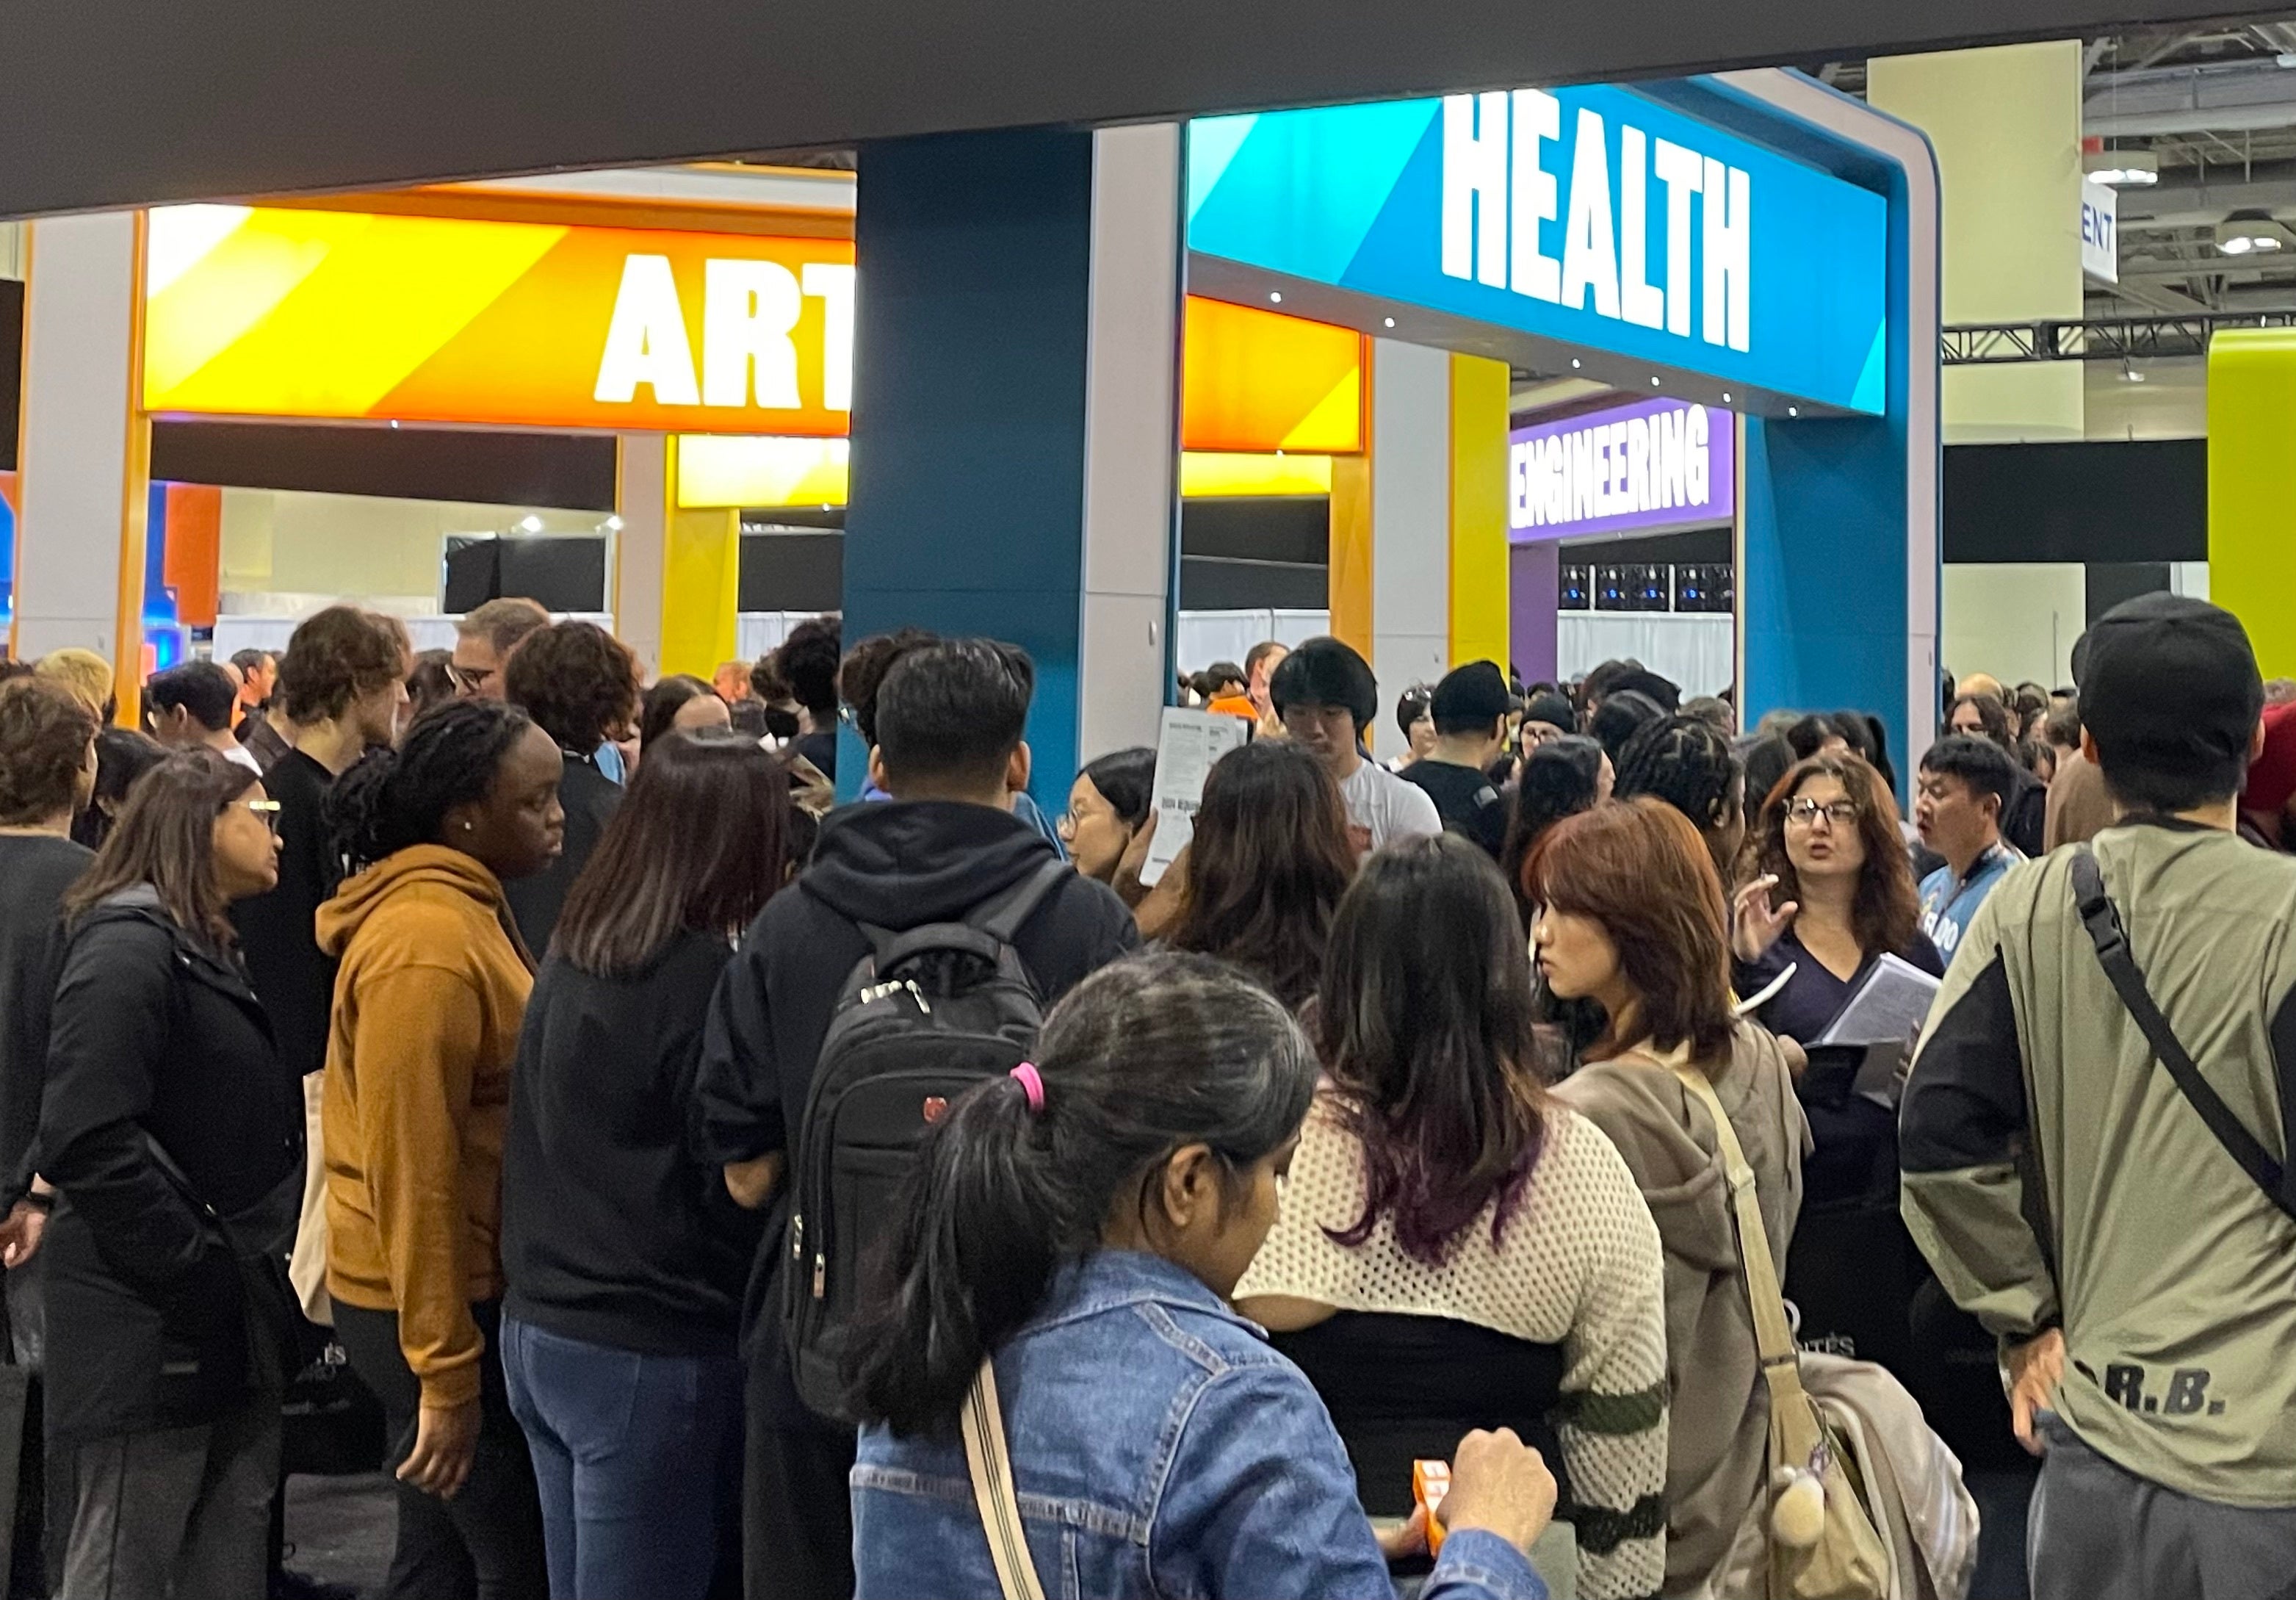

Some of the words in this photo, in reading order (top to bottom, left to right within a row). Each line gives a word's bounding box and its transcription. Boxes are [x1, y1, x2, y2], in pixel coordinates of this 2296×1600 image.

[1442, 88, 1750, 353] HEALTH
[2082, 201, 2112, 253] ENT
[1511, 403, 1709, 529] ENGINEERING
[2104, 1364, 2225, 1416] R.B.
